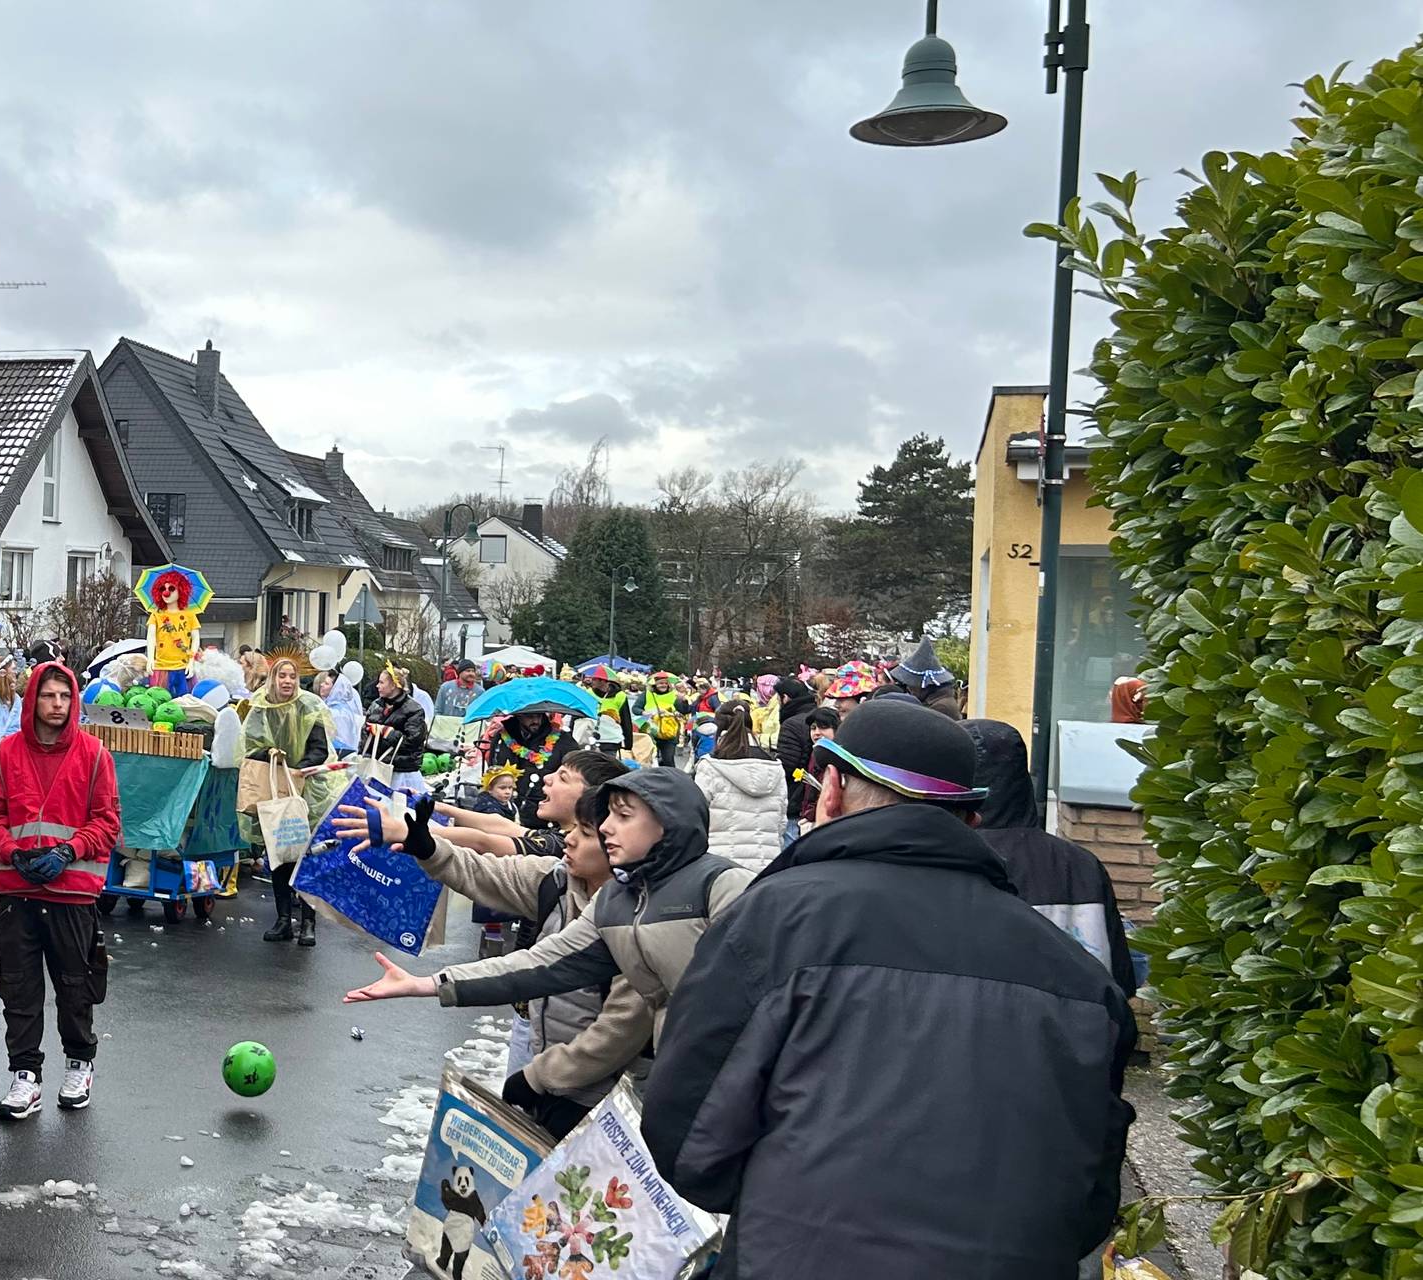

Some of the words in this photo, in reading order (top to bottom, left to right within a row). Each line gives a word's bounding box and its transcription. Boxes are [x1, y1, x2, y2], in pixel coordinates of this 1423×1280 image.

[1007, 543, 1033, 559] 52
[446, 1126, 462, 1141] DER
[461, 1135, 489, 1160] UMWELT
[487, 1153, 497, 1168] ZU
[598, 1111, 634, 1157] FRISCHE
[625, 1149, 650, 1179] ZUM
[640, 1172, 690, 1238] MITNEHMEN!
